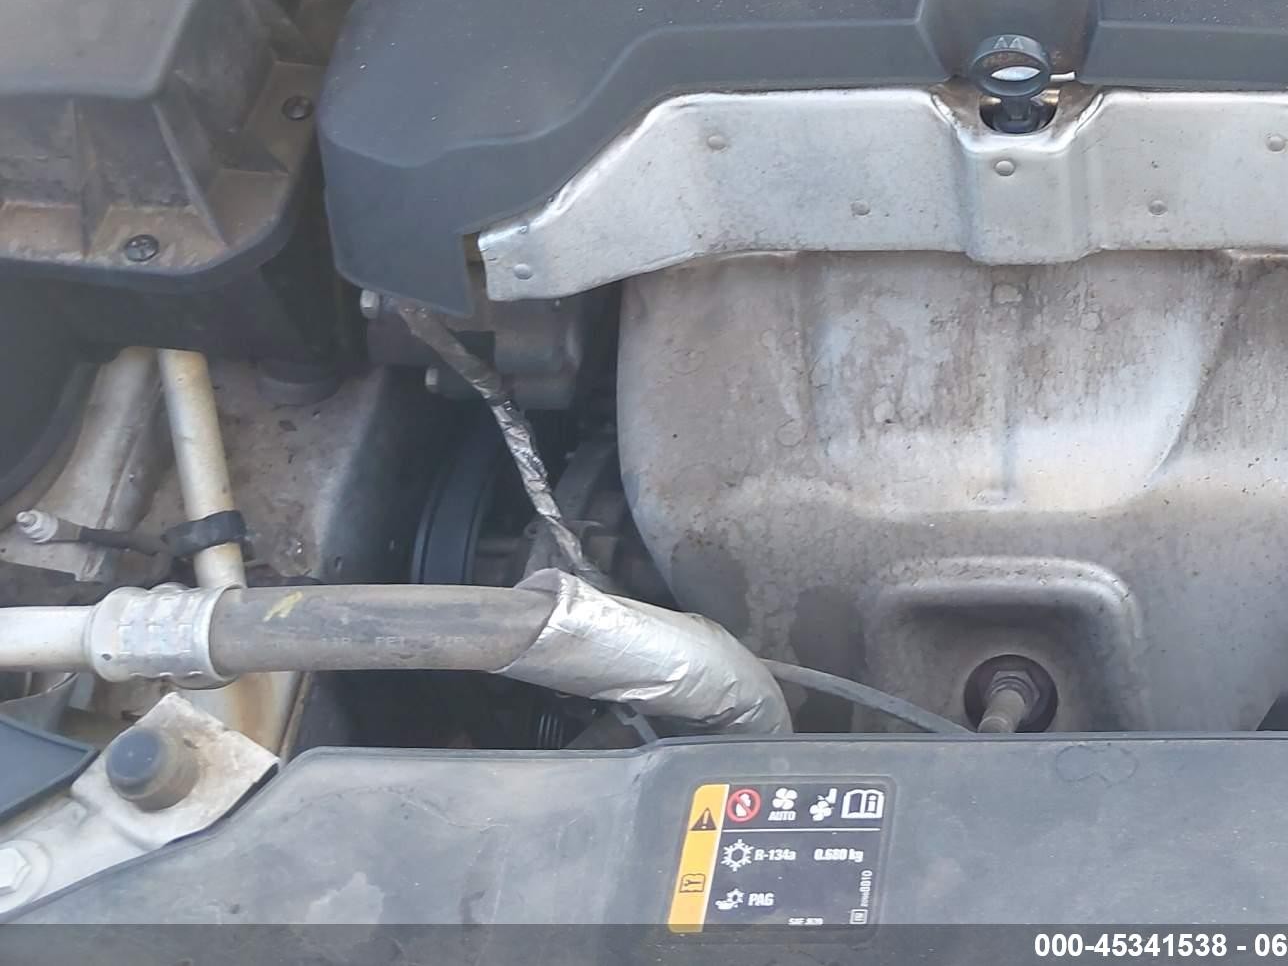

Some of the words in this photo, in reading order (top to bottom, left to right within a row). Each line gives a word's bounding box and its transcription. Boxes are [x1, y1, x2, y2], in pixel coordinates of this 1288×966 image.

[768, 810, 796, 821] AUTO
[754, 849, 796, 861] R-134a
[848, 848, 864, 863] kg
[748, 892, 775, 906] PAG
